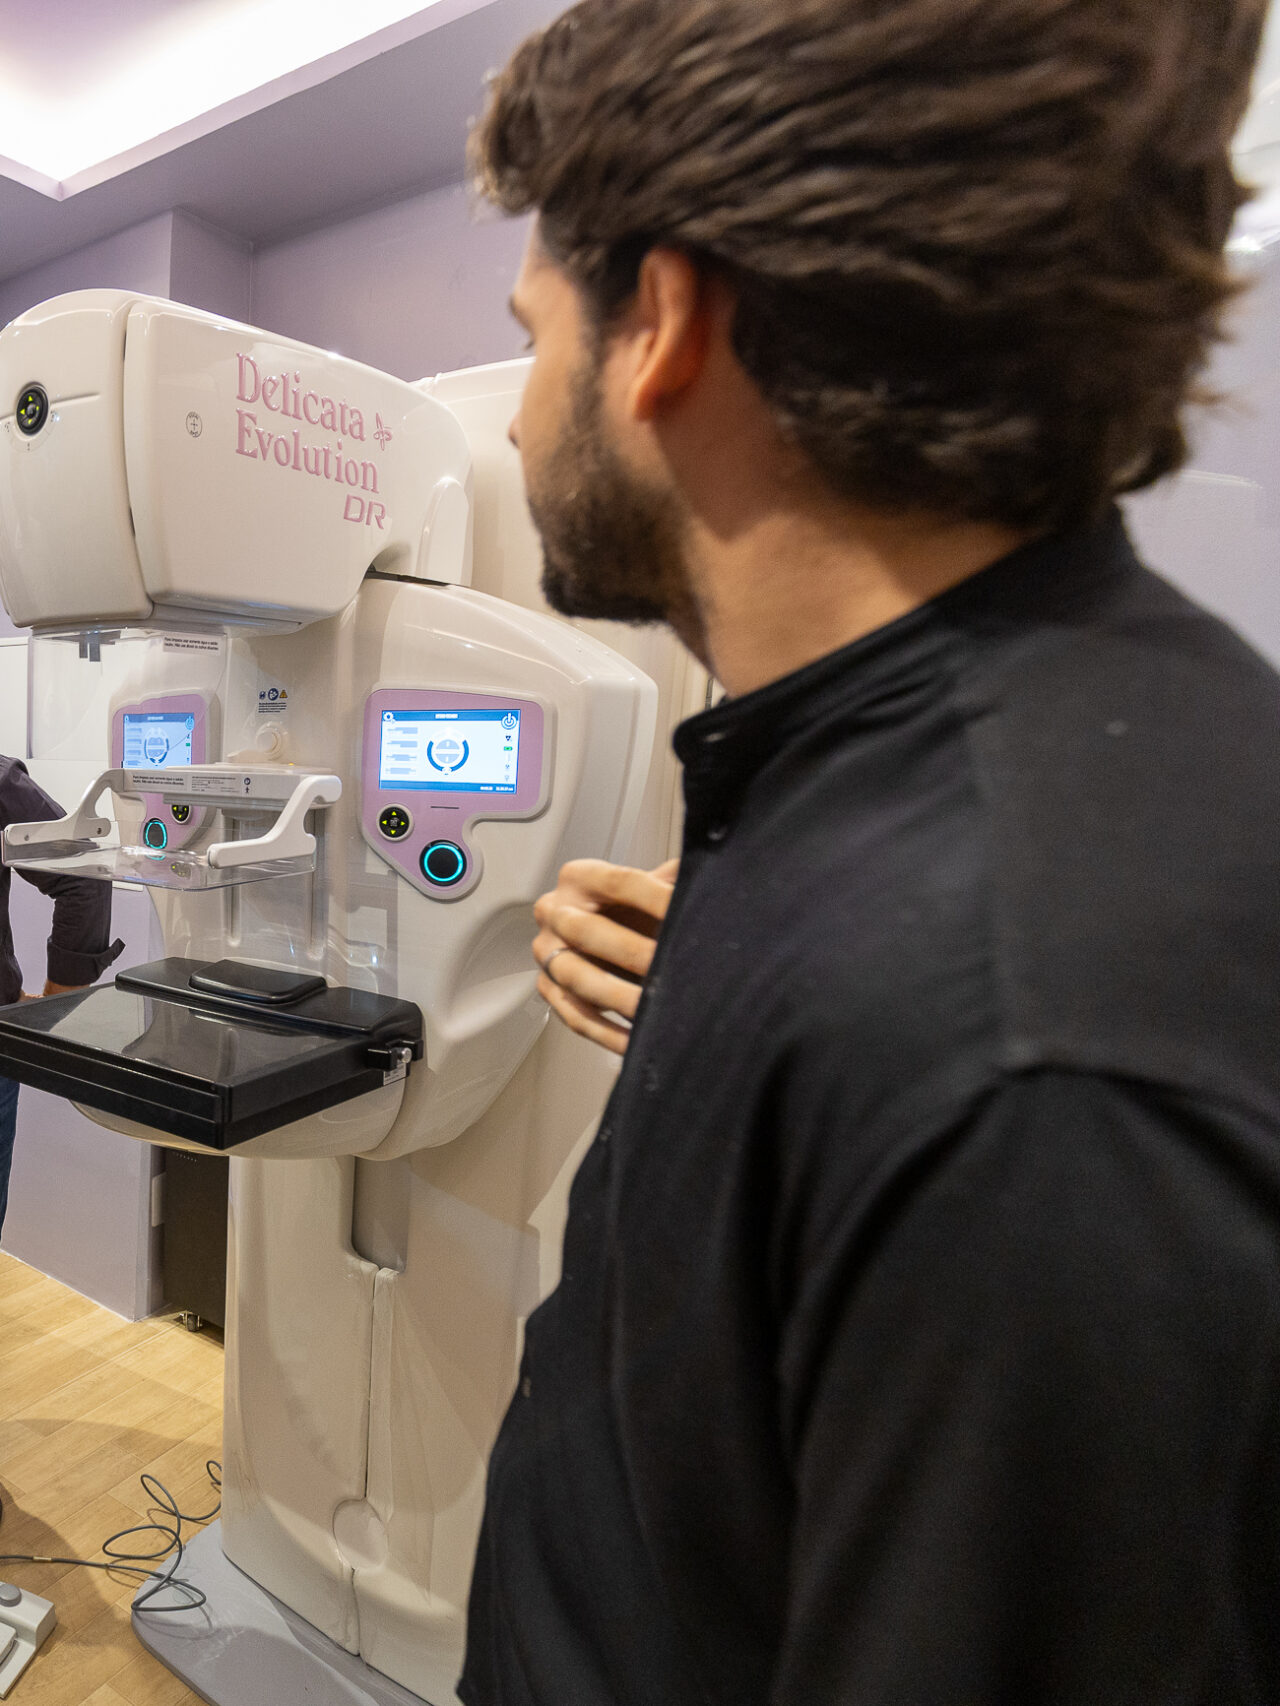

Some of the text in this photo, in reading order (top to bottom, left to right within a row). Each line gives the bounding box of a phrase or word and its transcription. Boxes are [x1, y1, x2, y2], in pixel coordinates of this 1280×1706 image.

[236, 352, 366, 441] Delicata
[235, 408, 379, 494] Evolution
[343, 494, 386, 530] DR
